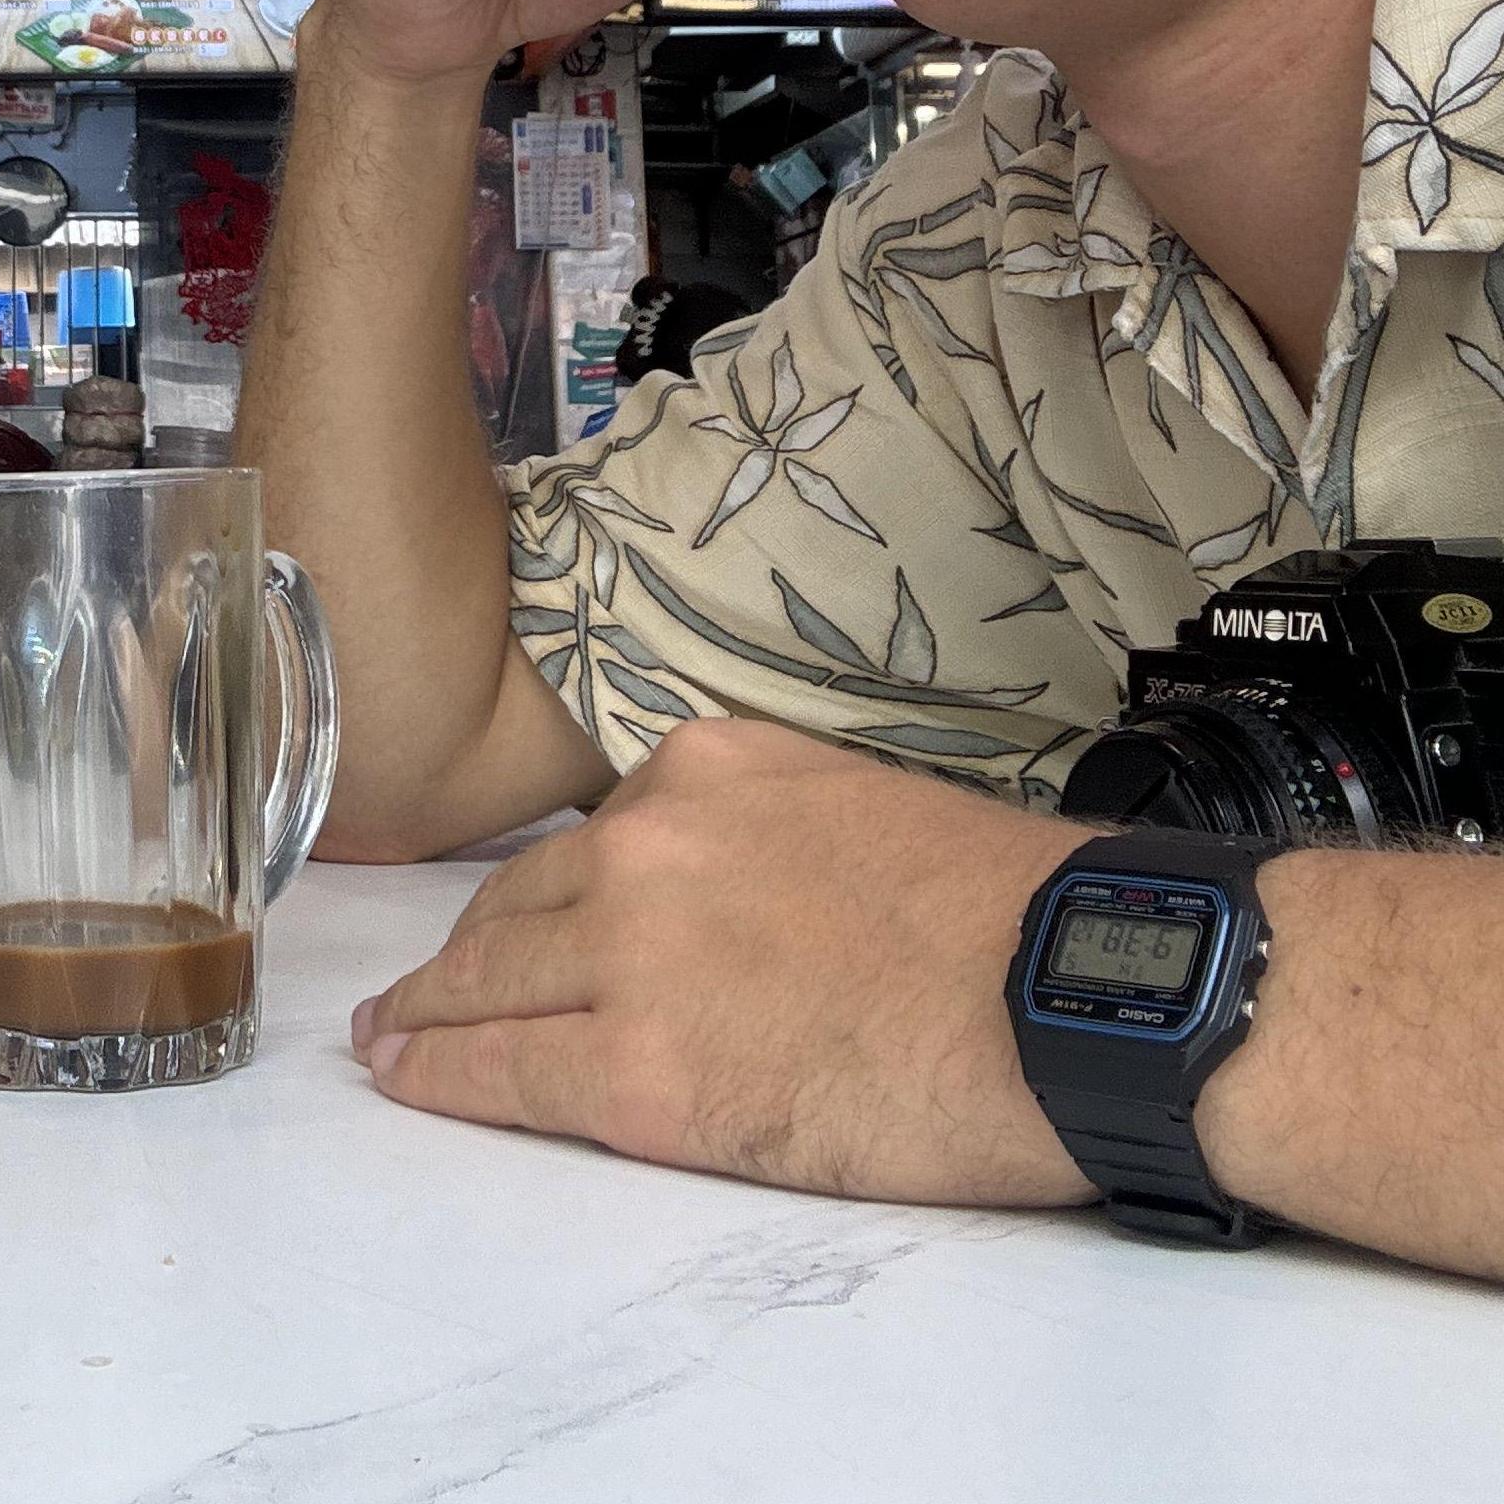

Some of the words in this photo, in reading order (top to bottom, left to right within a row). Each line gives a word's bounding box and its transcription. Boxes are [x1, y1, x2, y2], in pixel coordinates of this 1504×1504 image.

[1212, 607, 1328, 643] MINOLTA
[1072, 885, 1113, 896] RESIST
[1167, 896, 1206, 907] WATER
[1049, 998, 1095, 1014] F-91W
[1117, 1007, 1166, 1024] CASIO
